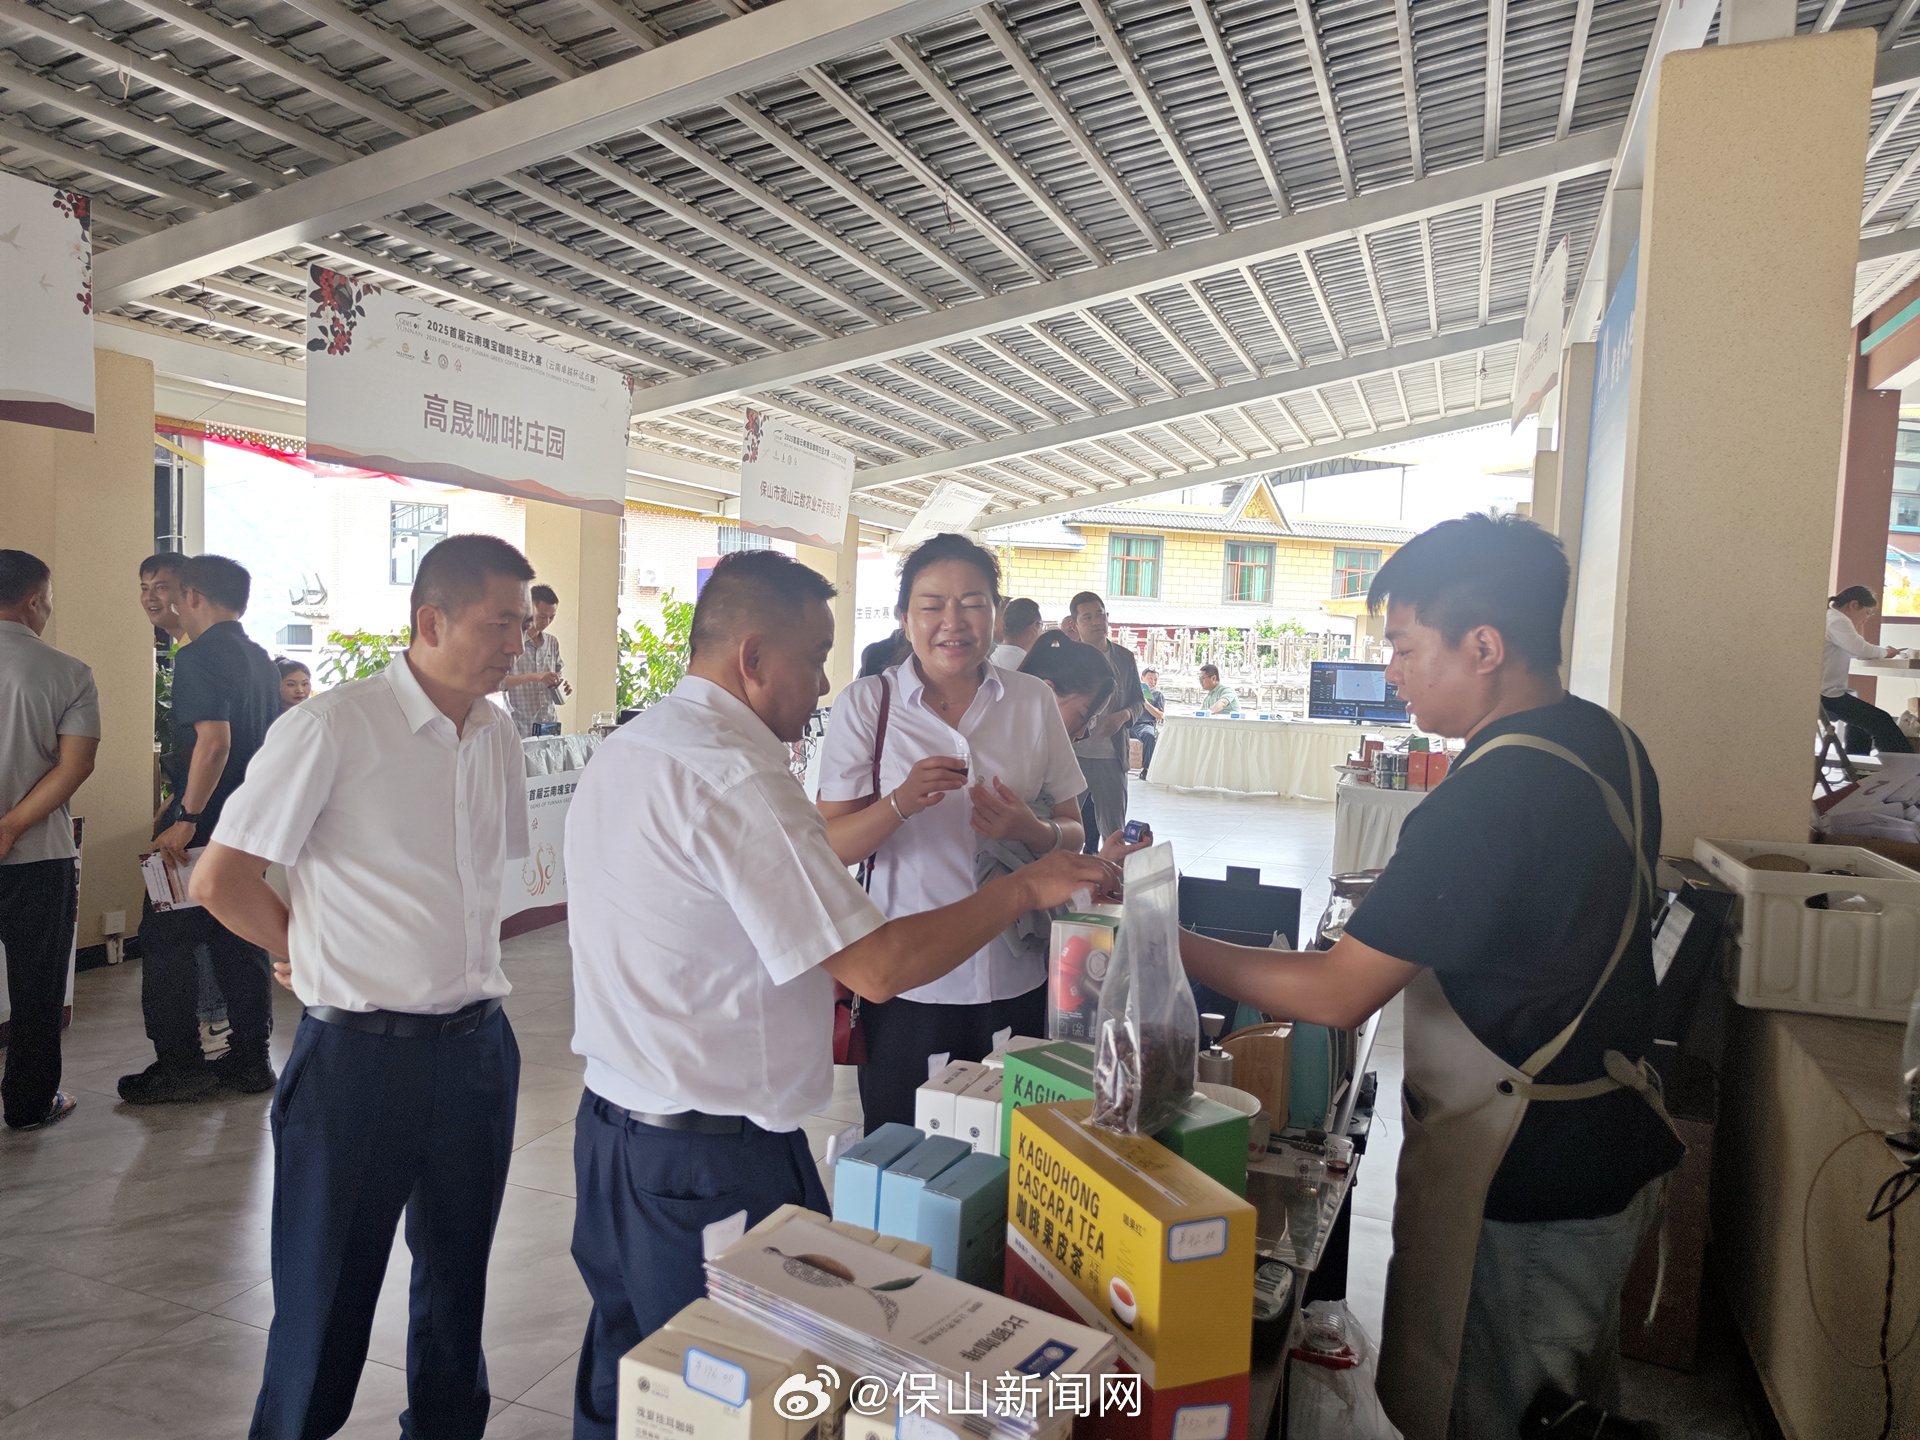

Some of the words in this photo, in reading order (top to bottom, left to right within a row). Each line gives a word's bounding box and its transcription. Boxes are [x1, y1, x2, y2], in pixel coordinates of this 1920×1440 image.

[423, 393, 566, 461] 高晟咖啡庄园
[1017, 1162, 1075, 1233] CASCARA
[1079, 1213, 1105, 1260] TEA
[1018, 1132, 1101, 1220] KAGUOHONG
[1016, 1192, 1085, 1280] 咖啡果皮茶
[958, 1314, 1029, 1363] 比顿咖啡
